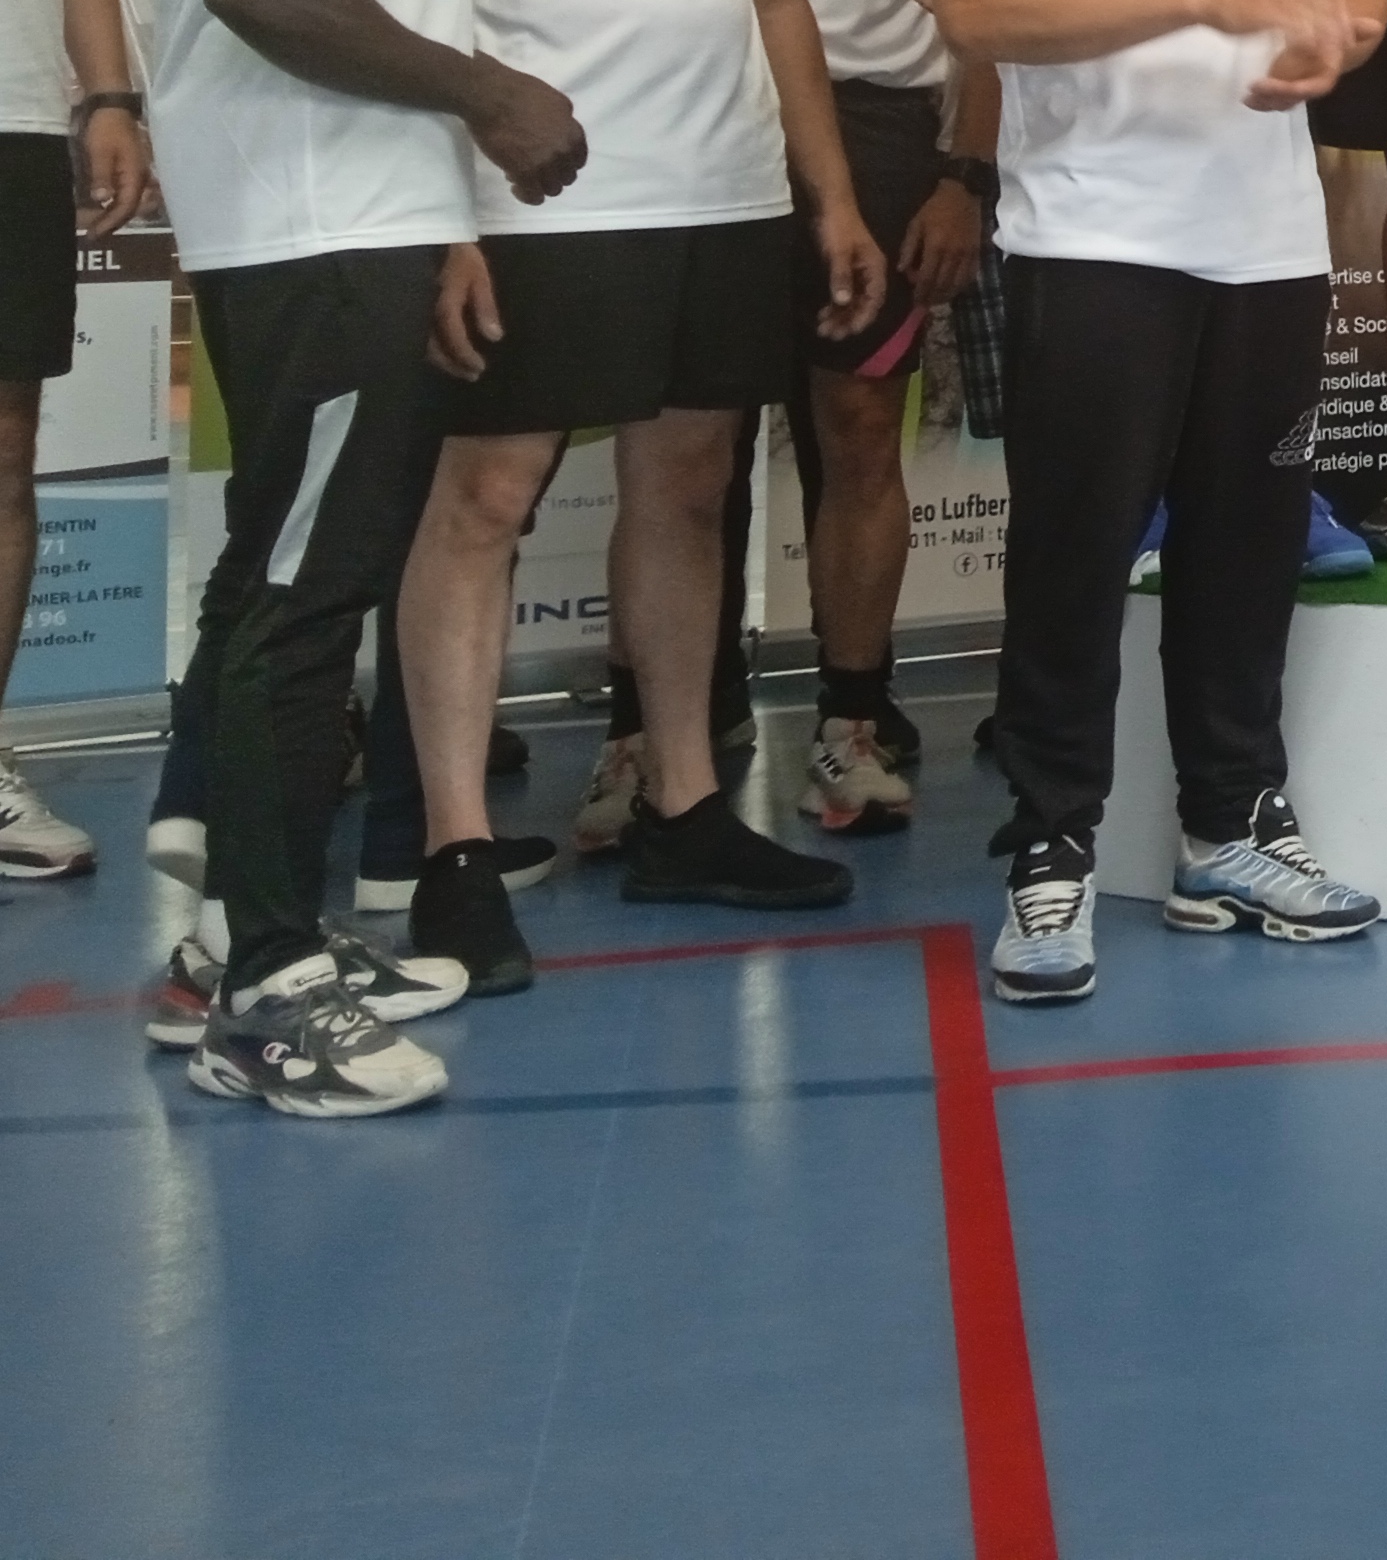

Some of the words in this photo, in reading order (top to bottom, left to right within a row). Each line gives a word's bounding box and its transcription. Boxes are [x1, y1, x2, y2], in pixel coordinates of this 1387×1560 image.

[1328, 268, 1373, 286] ertise
[1336, 318, 1349, 334] &
[1312, 452, 1373, 473] ratégie
[942, 493, 1010, 521] Lufber
[33, 559, 91, 577] nge.fr
